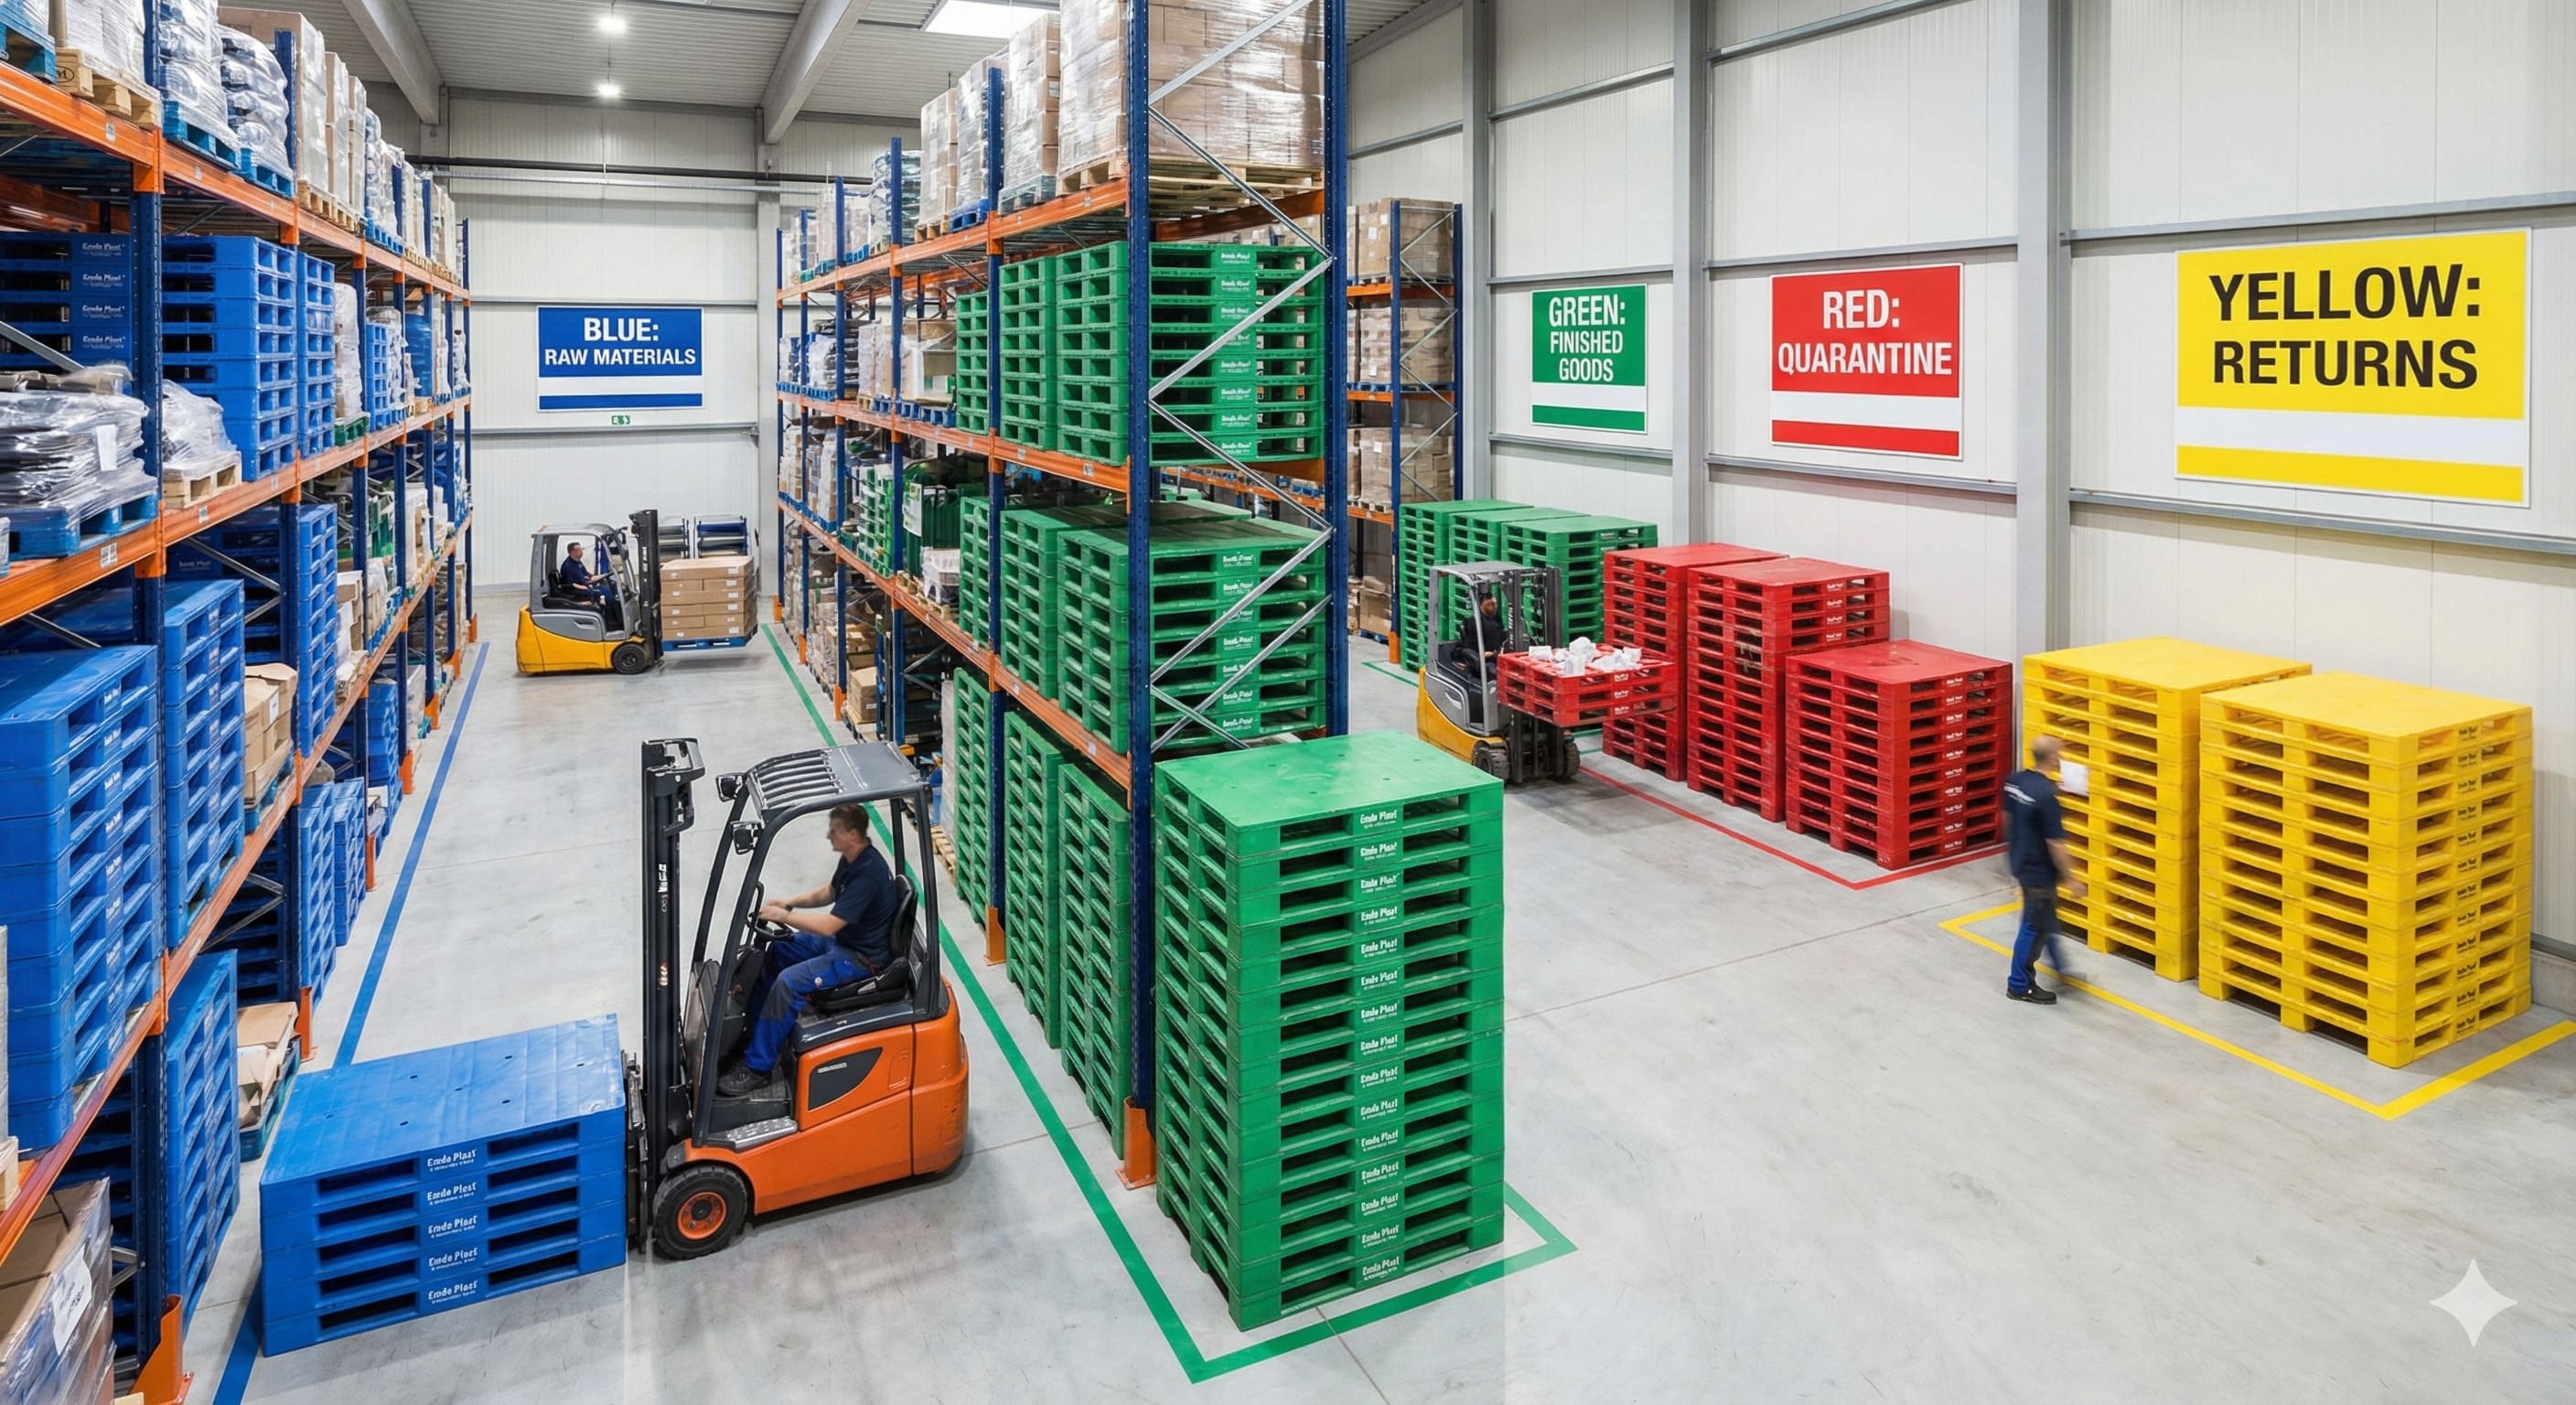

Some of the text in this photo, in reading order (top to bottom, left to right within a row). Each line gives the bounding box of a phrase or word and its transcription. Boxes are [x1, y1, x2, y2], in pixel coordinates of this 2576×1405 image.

[1823, 289, 1900, 328] RED:
[2208, 263, 2480, 321] YELLOW:
[1549, 294, 1626, 327] GREEN:
[584, 316, 659, 341] BLUE:
[1551, 330, 1624, 354] FINISHED
[544, 349, 696, 365] RAW MATERIALS
[1559, 358, 1614, 381] GOODS
[1777, 342, 1952, 375] QUARANTINE
[2214, 339, 2477, 389] RETURNS
